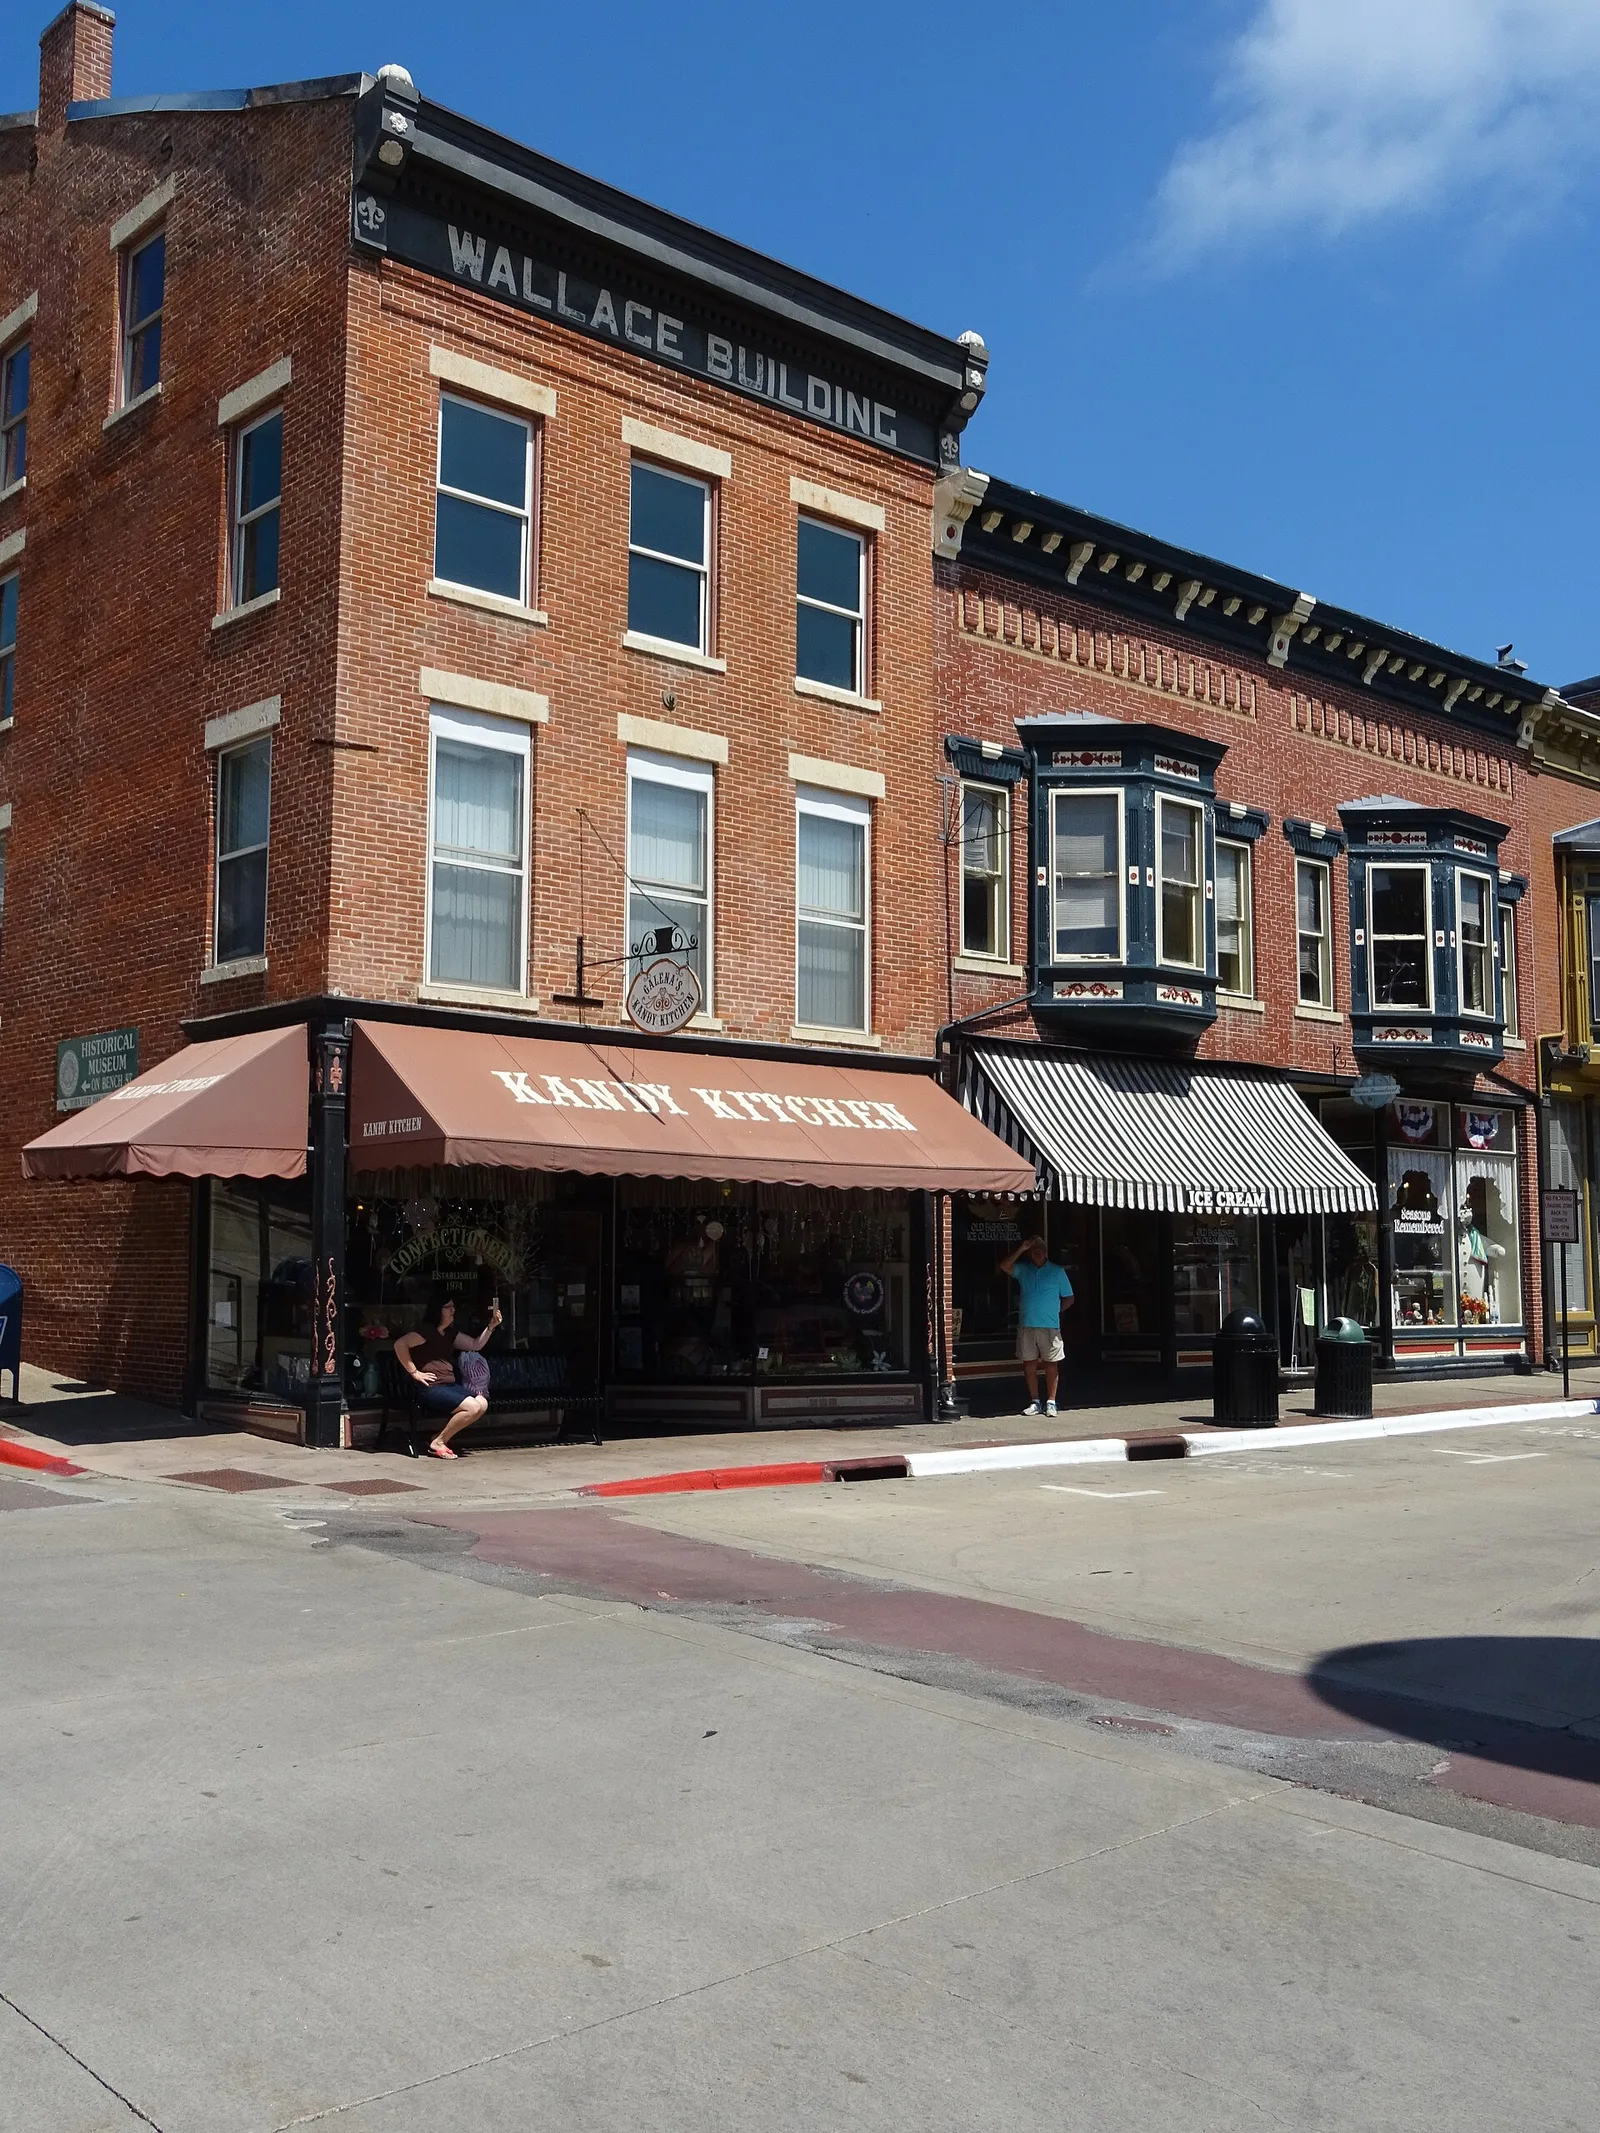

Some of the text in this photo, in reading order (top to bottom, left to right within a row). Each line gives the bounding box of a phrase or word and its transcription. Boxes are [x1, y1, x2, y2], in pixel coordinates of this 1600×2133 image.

[447, 223, 898, 446] WALLACE BUILDING
[642, 972, 683, 995] GALENA'S
[631, 992, 695, 1026] KANDY KITCHEN
[81, 1033, 135, 1058] HISTORICAL
[88, 1054, 127, 1076] MUSEUM
[91, 1078, 101, 1092] ON
[102, 1073, 122, 1090] BENCH
[490, 1070, 918, 1131] KANDY KITCHEN
[363, 1116, 422, 1137] KANDY KITCHEN
[1188, 1190, 1267, 1208] ICE CREAM
[1400, 1207, 1432, 1221] Seasons
[966, 1231, 1022, 1241] ICE CREAM PARLOR
[970, 1222, 1018, 1232] OLD FASHIONED
[1393, 1219, 1445, 1235] Remembered
[389, 1227, 515, 1275] CONFECTIONERY
[446, 1281, 463, 1291] 1974
